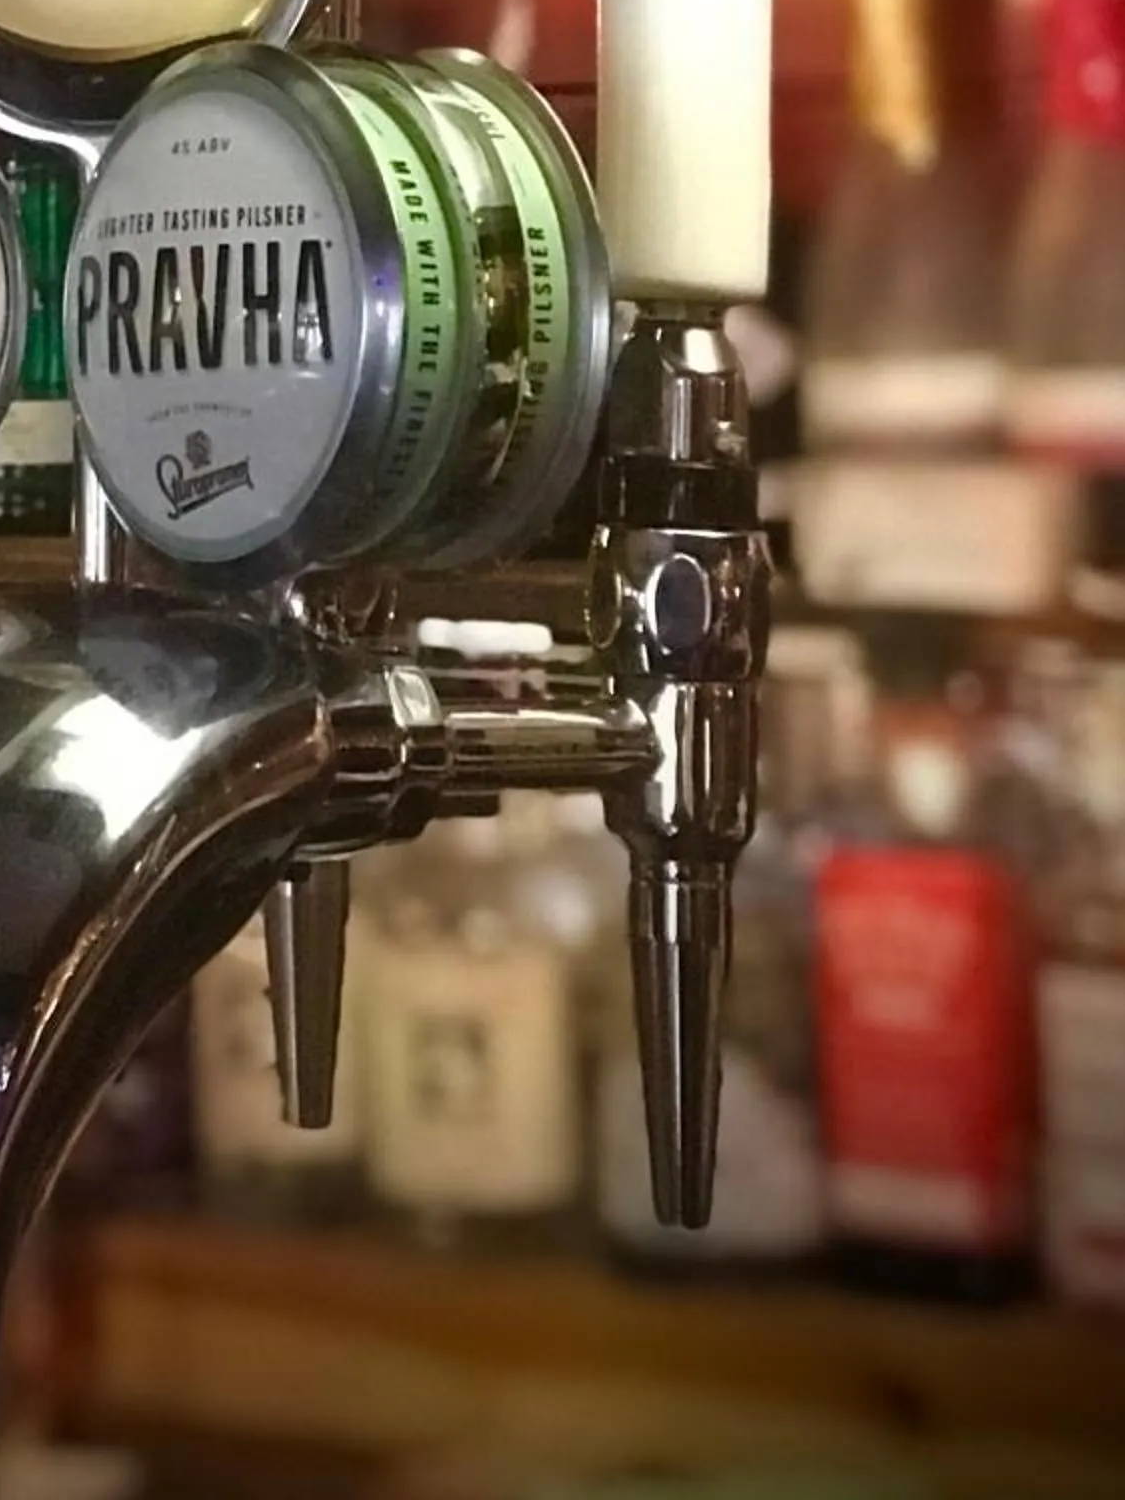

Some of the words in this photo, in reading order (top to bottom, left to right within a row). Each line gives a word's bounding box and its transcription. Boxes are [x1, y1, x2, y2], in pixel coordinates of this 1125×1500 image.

[163, 205, 230, 231] TASTING
[237, 204, 306, 228] PILSNER
[389, 160, 429, 223] MADE
[416, 239, 441, 306] WITH
[527, 227, 554, 344] PILSNER
[77, 239, 333, 376] PRAVHA
[418, 324, 441, 373] THE
